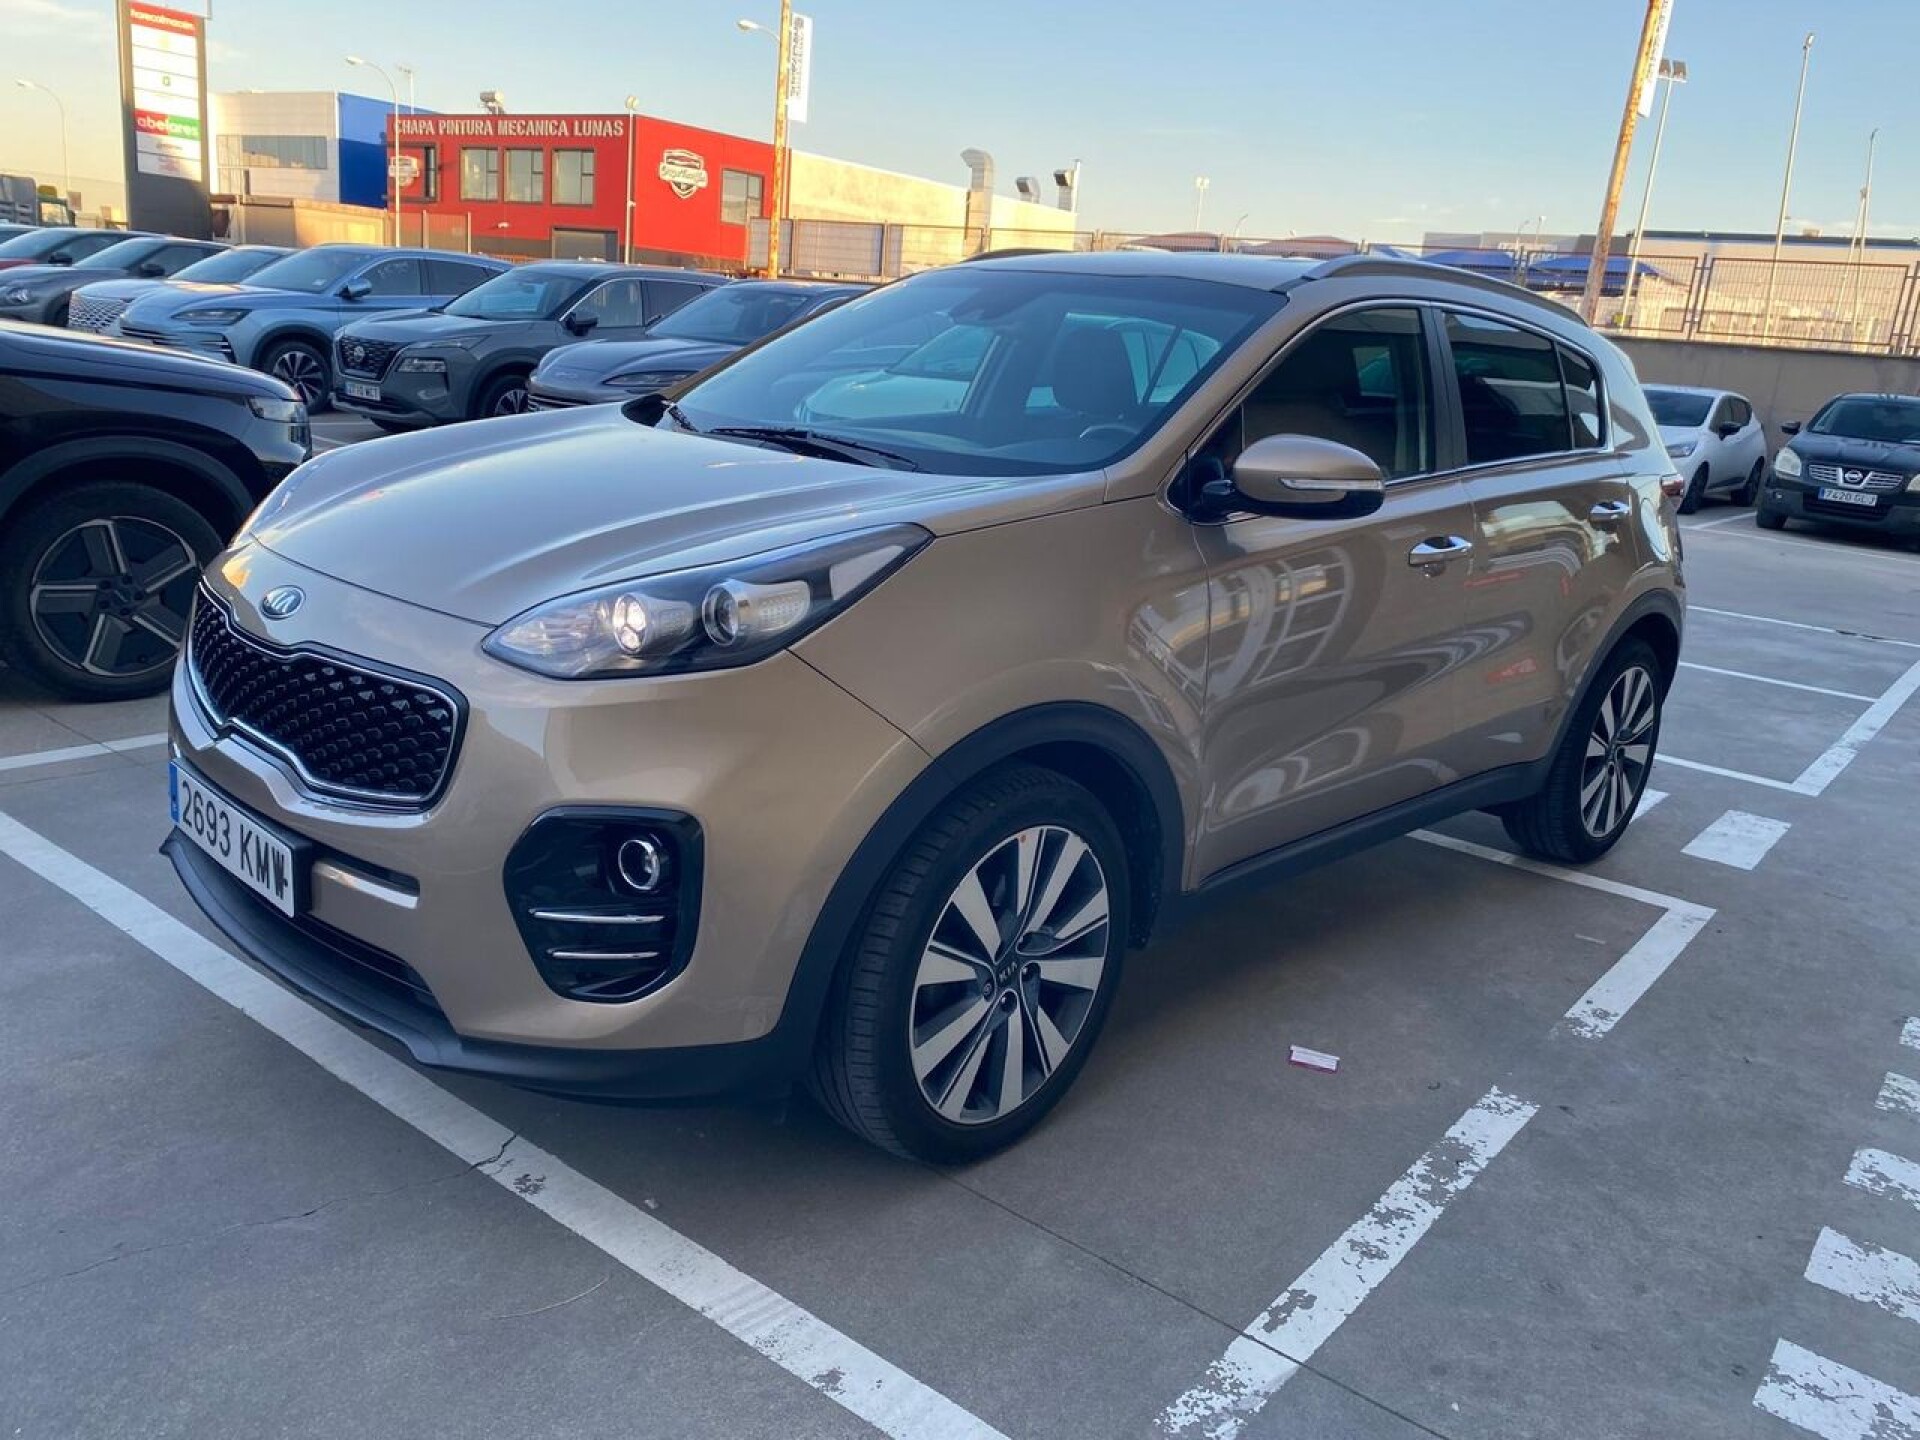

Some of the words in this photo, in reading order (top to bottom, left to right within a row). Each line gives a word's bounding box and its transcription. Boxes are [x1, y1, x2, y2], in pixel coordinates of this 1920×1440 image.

[438, 120, 494, 136] PINTURA
[498, 119, 568, 137] MECANICA
[574, 120, 624, 137] LUNAS
[182, 780, 231, 858] 2693
[239, 825, 289, 901] KMW
